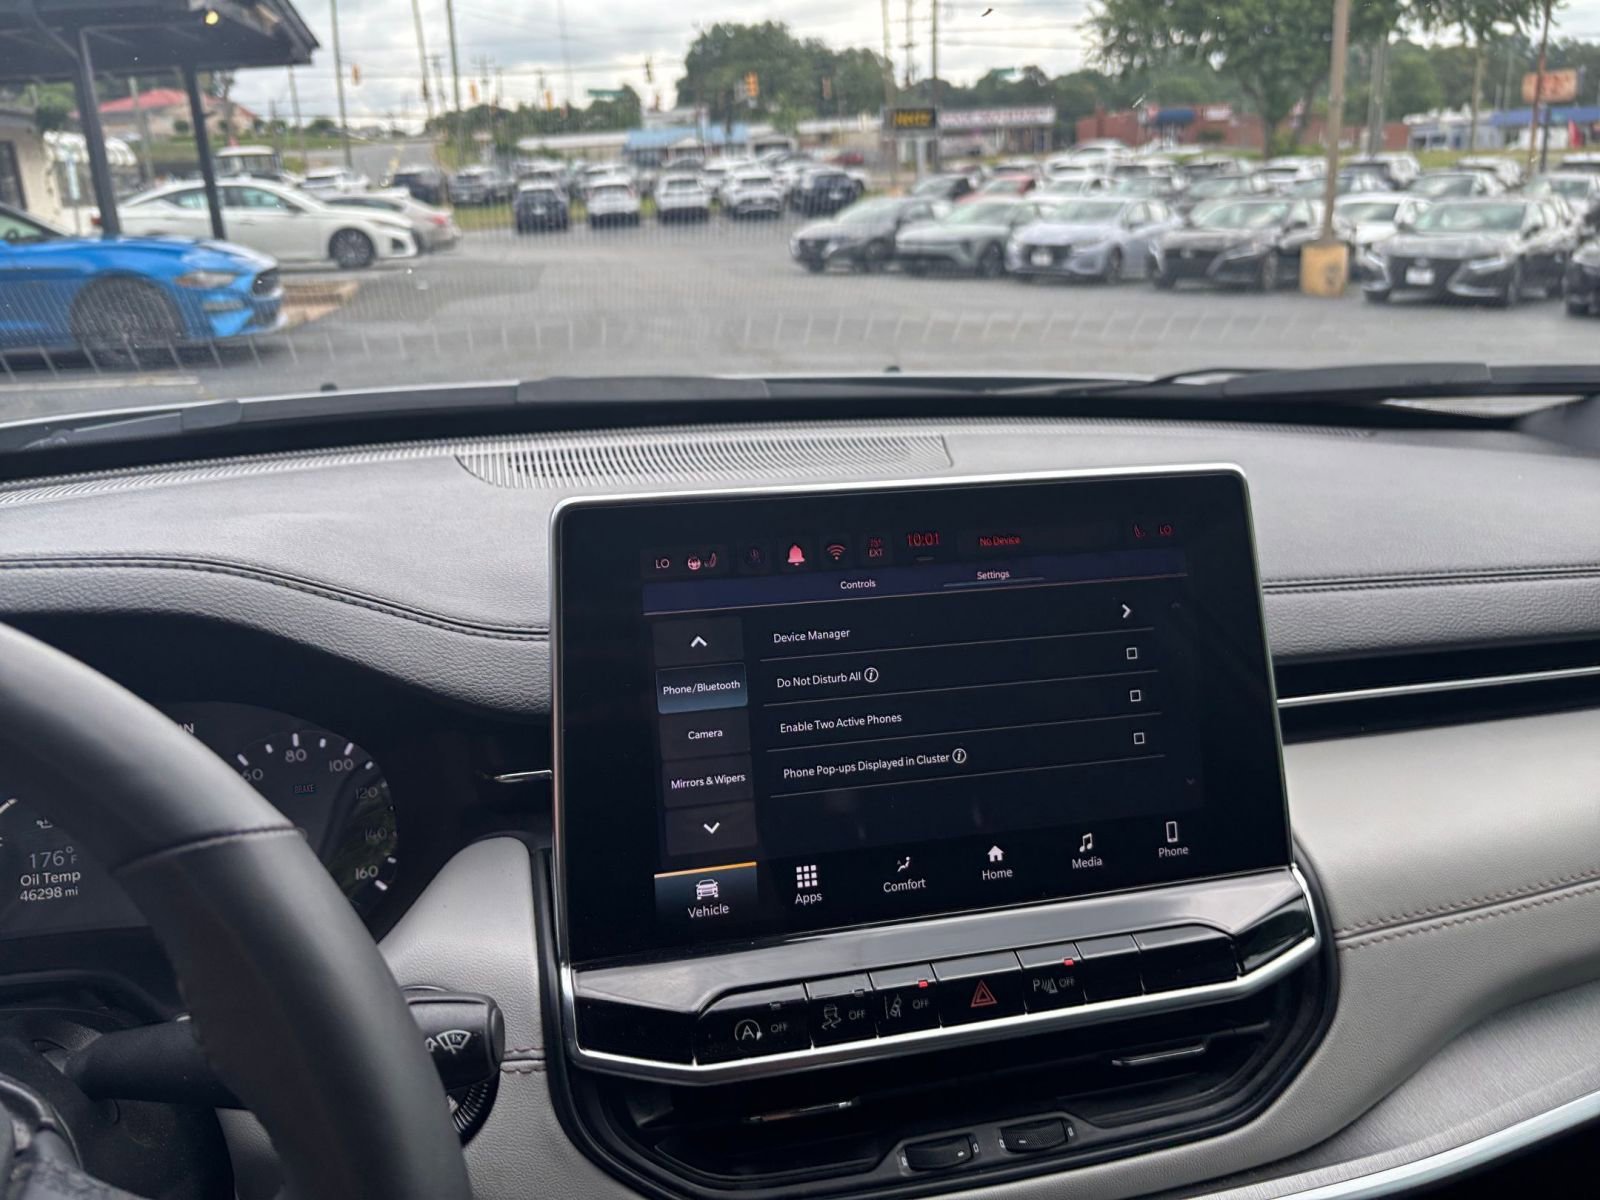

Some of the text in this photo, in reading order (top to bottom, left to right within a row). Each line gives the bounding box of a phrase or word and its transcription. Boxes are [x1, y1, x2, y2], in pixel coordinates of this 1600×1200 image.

[1159, 525, 1173, 535] LO
[907, 533, 939, 547] 10:01
[979, 535, 1021, 546] No Device
[869, 549, 883, 558] EXT
[655, 559, 670, 569] LO
[977, 570, 1010, 582] Settings
[840, 579, 876, 590] Controls
[773, 629, 850, 643] Device Manager
[777, 672, 861, 688] Do Not Disturb All
[663, 680, 741, 695] Phone/Bluetooth
[780, 712, 902, 733] Enable Two Active Phones
[688, 728, 723, 740] Camera
[285, 748, 307, 762] 80
[329, 758, 354, 772] 100
[783, 752, 950, 779] Phone Pop-ups Displayed in Cluster
[671, 772, 746, 790] Mirrors & Wipers
[294, 784, 314, 793] BRAKE
[355, 786, 378, 799] 120
[1158, 845, 1189, 858] Phone
[1072, 856, 1103, 869] Media
[20, 871, 81, 887] Oil Temp
[355, 865, 378, 880] 160
[982, 868, 1013, 881] Home
[883, 878, 926, 893] Comfort
[20, 886, 78, 902] 46298 mi
[795, 891, 822, 906] Apps
[688, 903, 729, 919] Vehicle
[1058, 975, 1075, 989] OFF
[912, 997, 929, 1010] OFF
